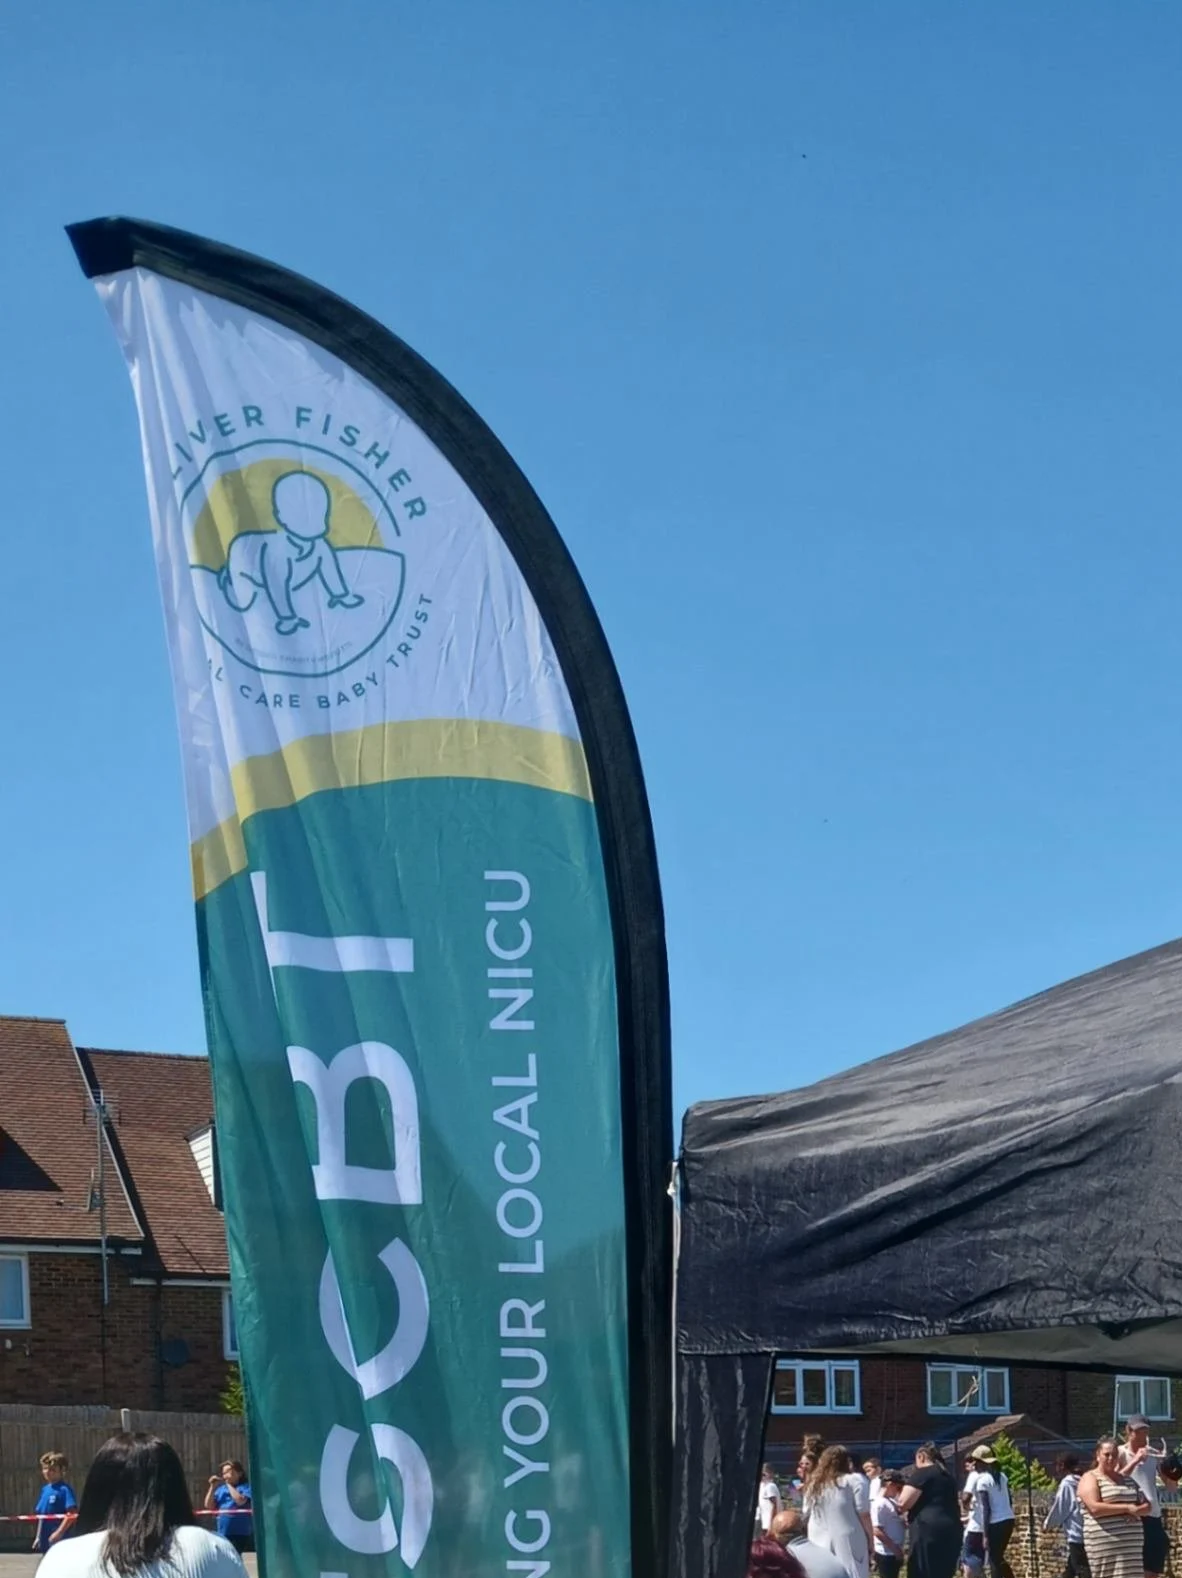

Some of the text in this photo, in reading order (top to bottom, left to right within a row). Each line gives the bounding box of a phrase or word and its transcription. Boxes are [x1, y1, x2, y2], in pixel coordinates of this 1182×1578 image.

[295, 406, 427, 520] FISHER
[239, 684, 301, 709] CARE
[317, 672, 380, 710] BABY
[386, 593, 433, 670] TRUST
[483, 869, 535, 1031] NICU
[491, 1053, 546, 1274] LOCAL
[499, 1298, 550, 1490] YOUR
